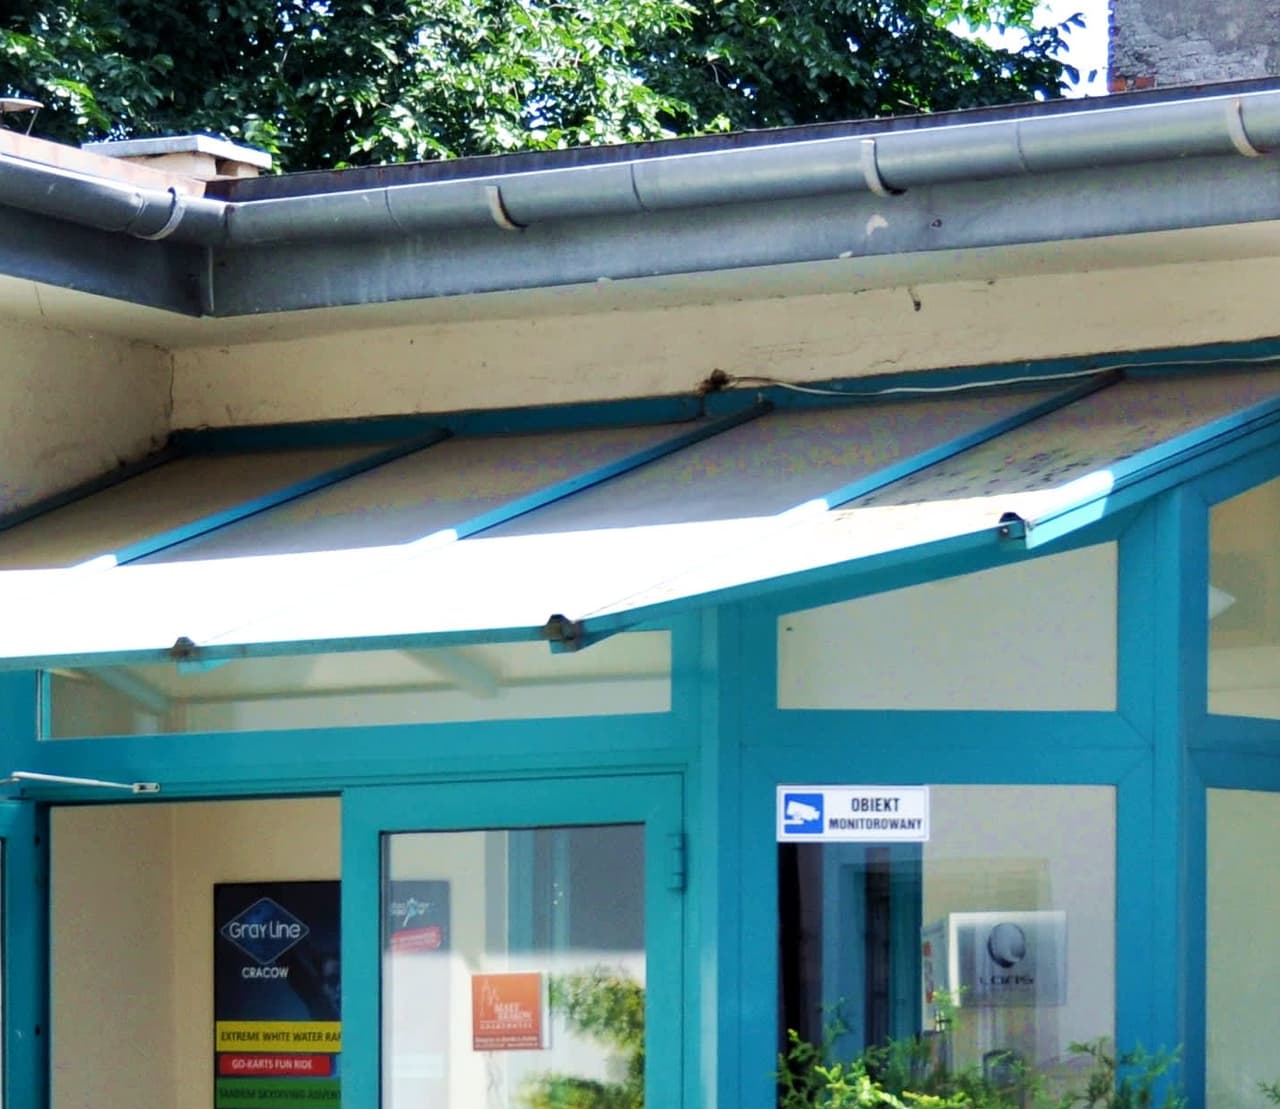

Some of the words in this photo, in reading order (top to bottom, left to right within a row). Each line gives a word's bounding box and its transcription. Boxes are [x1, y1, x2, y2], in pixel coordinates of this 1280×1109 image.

[851, 797, 900, 812] OBIEKT
[829, 818, 922, 830] MONITOROWANY
[242, 966, 289, 978] CRACOW
[221, 1031, 260, 1042] EXTREME
[262, 1031, 290, 1042] WHITE
[293, 1031, 323, 1042] WATER
[231, 1059, 273, 1070] GO-KARTS
[275, 1059, 293, 1070] FUN
[294, 1059, 313, 1070] RIDE
